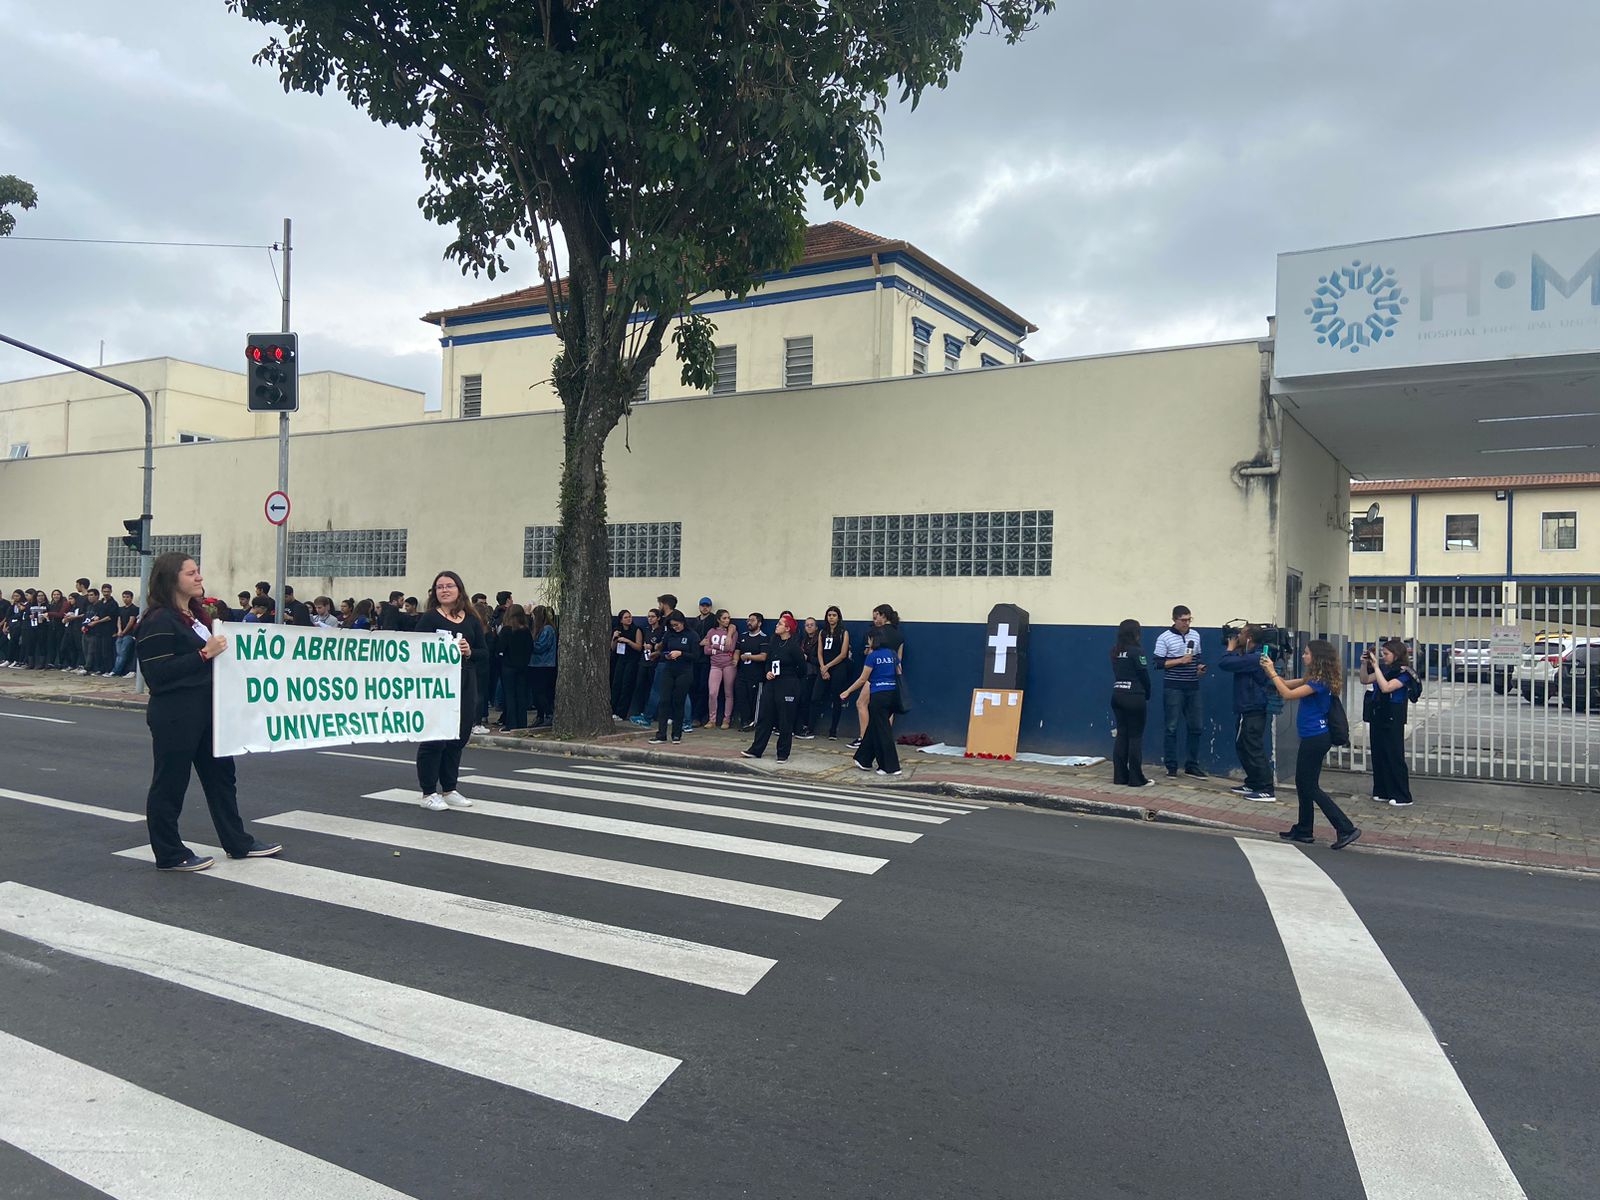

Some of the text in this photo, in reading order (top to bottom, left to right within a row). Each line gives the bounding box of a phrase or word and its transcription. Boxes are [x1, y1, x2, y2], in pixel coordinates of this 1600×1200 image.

[235, 628, 462, 666] NÃO ABRIREMOS MÃO
[246, 676, 457, 704] DO NOSSO HOSPITAL
[266, 706, 426, 743] UNIVERSITÁRIO
